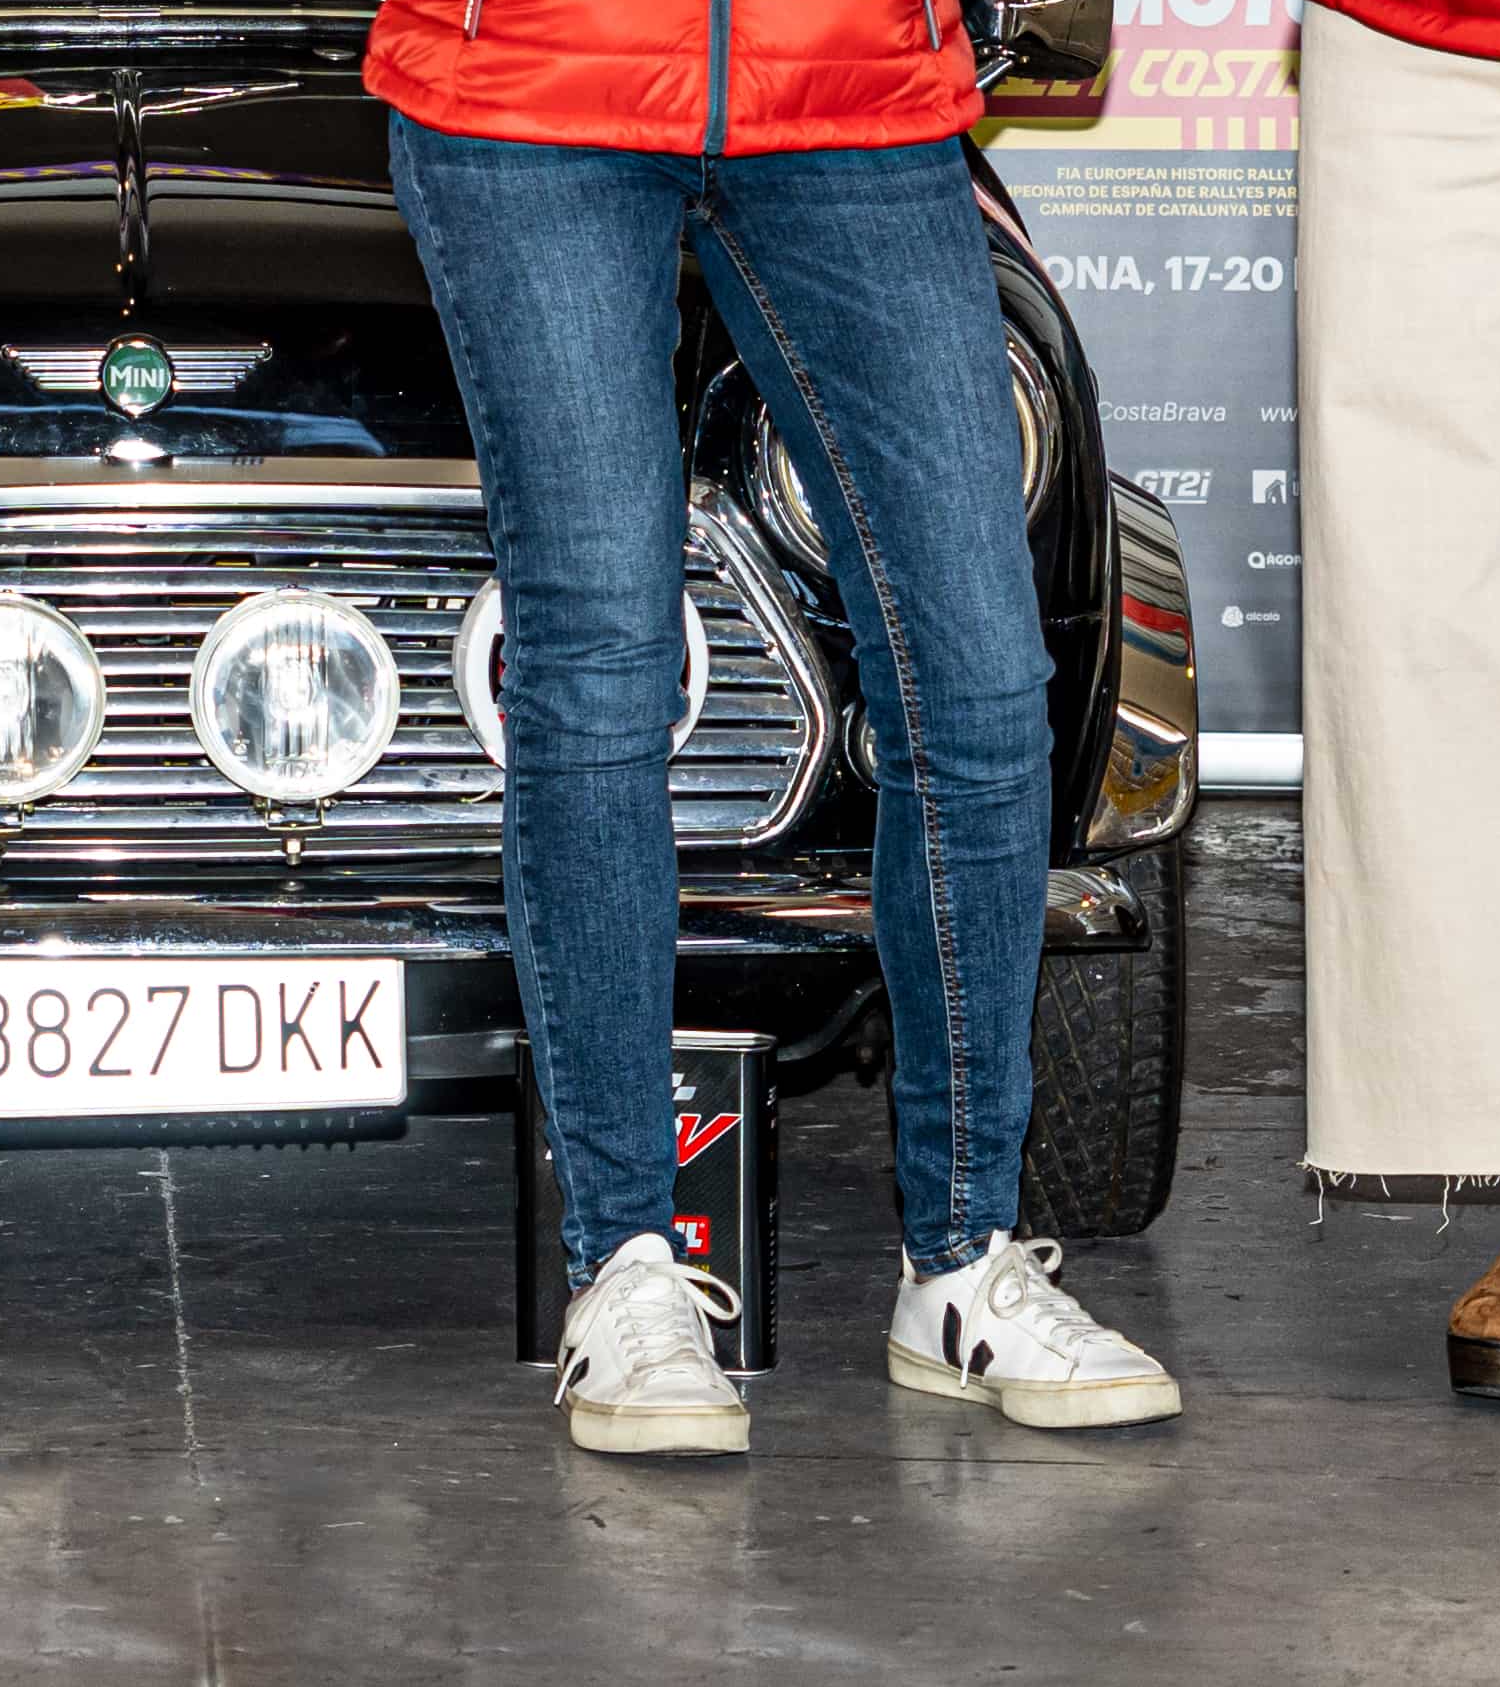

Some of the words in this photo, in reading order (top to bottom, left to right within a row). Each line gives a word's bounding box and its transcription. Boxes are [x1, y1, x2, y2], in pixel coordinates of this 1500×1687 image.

[1056, 167, 1081, 181] FIA
[1084, 167, 1168, 181] EUROPEAN
[1171, 167, 1245, 181] HISTORIC
[1248, 167, 1294, 181] RALLY
[1089, 185, 1109, 199] DE
[1112, 182, 1173, 199] ESPAÑA
[1176, 185, 1195, 199] DE
[1198, 185, 1265, 199] RALLYES
[1039, 203, 1130, 217] CAMPIONAT
[1135, 203, 1156, 217] DE
[1159, 203, 1248, 217] CATALUNYA
[1252, 203, 1272, 217] DE
[1275, 203, 1299, 217] VE
[1043, 256, 1156, 296] ONA,
[1164, 256, 1284, 292] 17-20
[109, 364, 166, 389] MINI
[217, 978, 384, 1074] DKK
